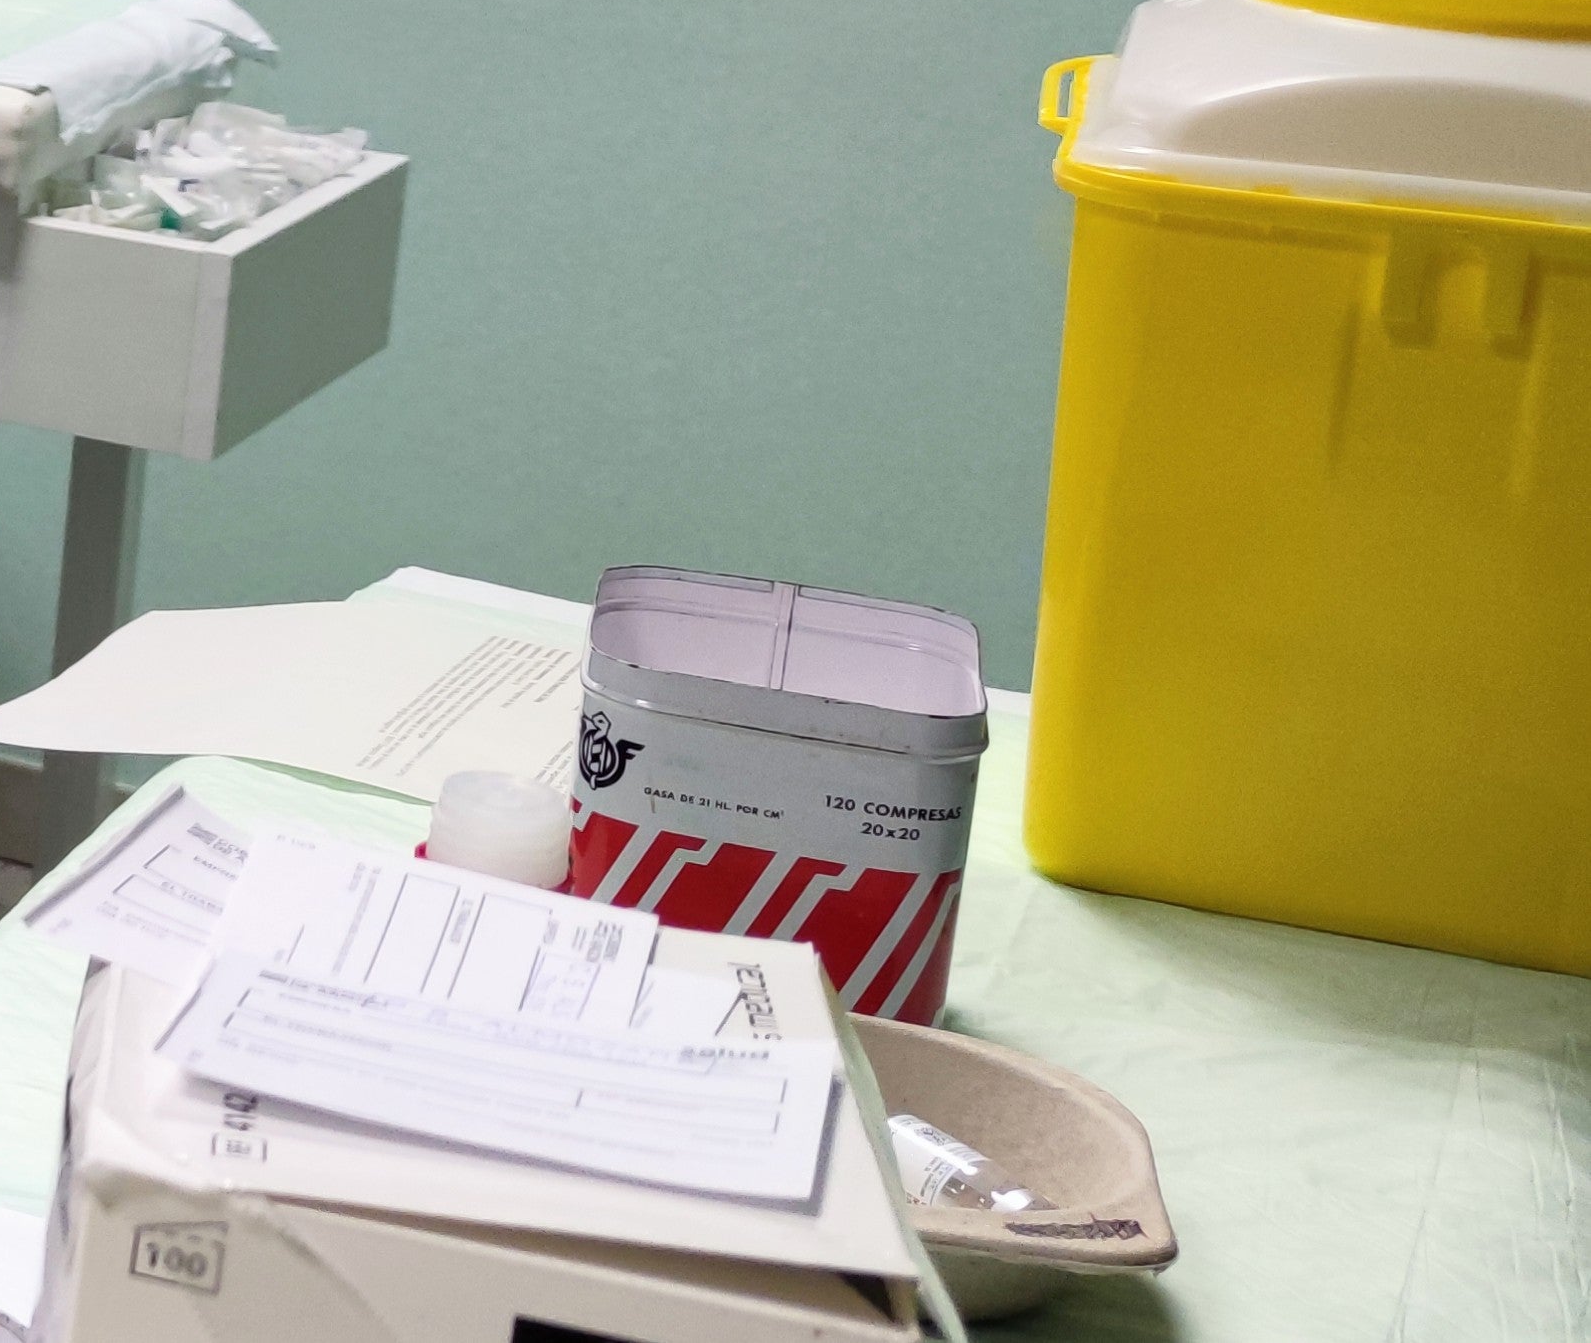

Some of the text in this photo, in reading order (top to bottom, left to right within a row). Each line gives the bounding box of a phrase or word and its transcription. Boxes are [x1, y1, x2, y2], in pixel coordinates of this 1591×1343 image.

[643, 786, 675, 801] GASA
[680, 793, 695, 805] DE
[699, 796, 711, 807] 21
[736, 804, 759, 815] POR
[824, 794, 962, 821] 120 COMPRESAS
[860, 821, 921, 841] 20x20
[145, 1241, 209, 1279] 100
